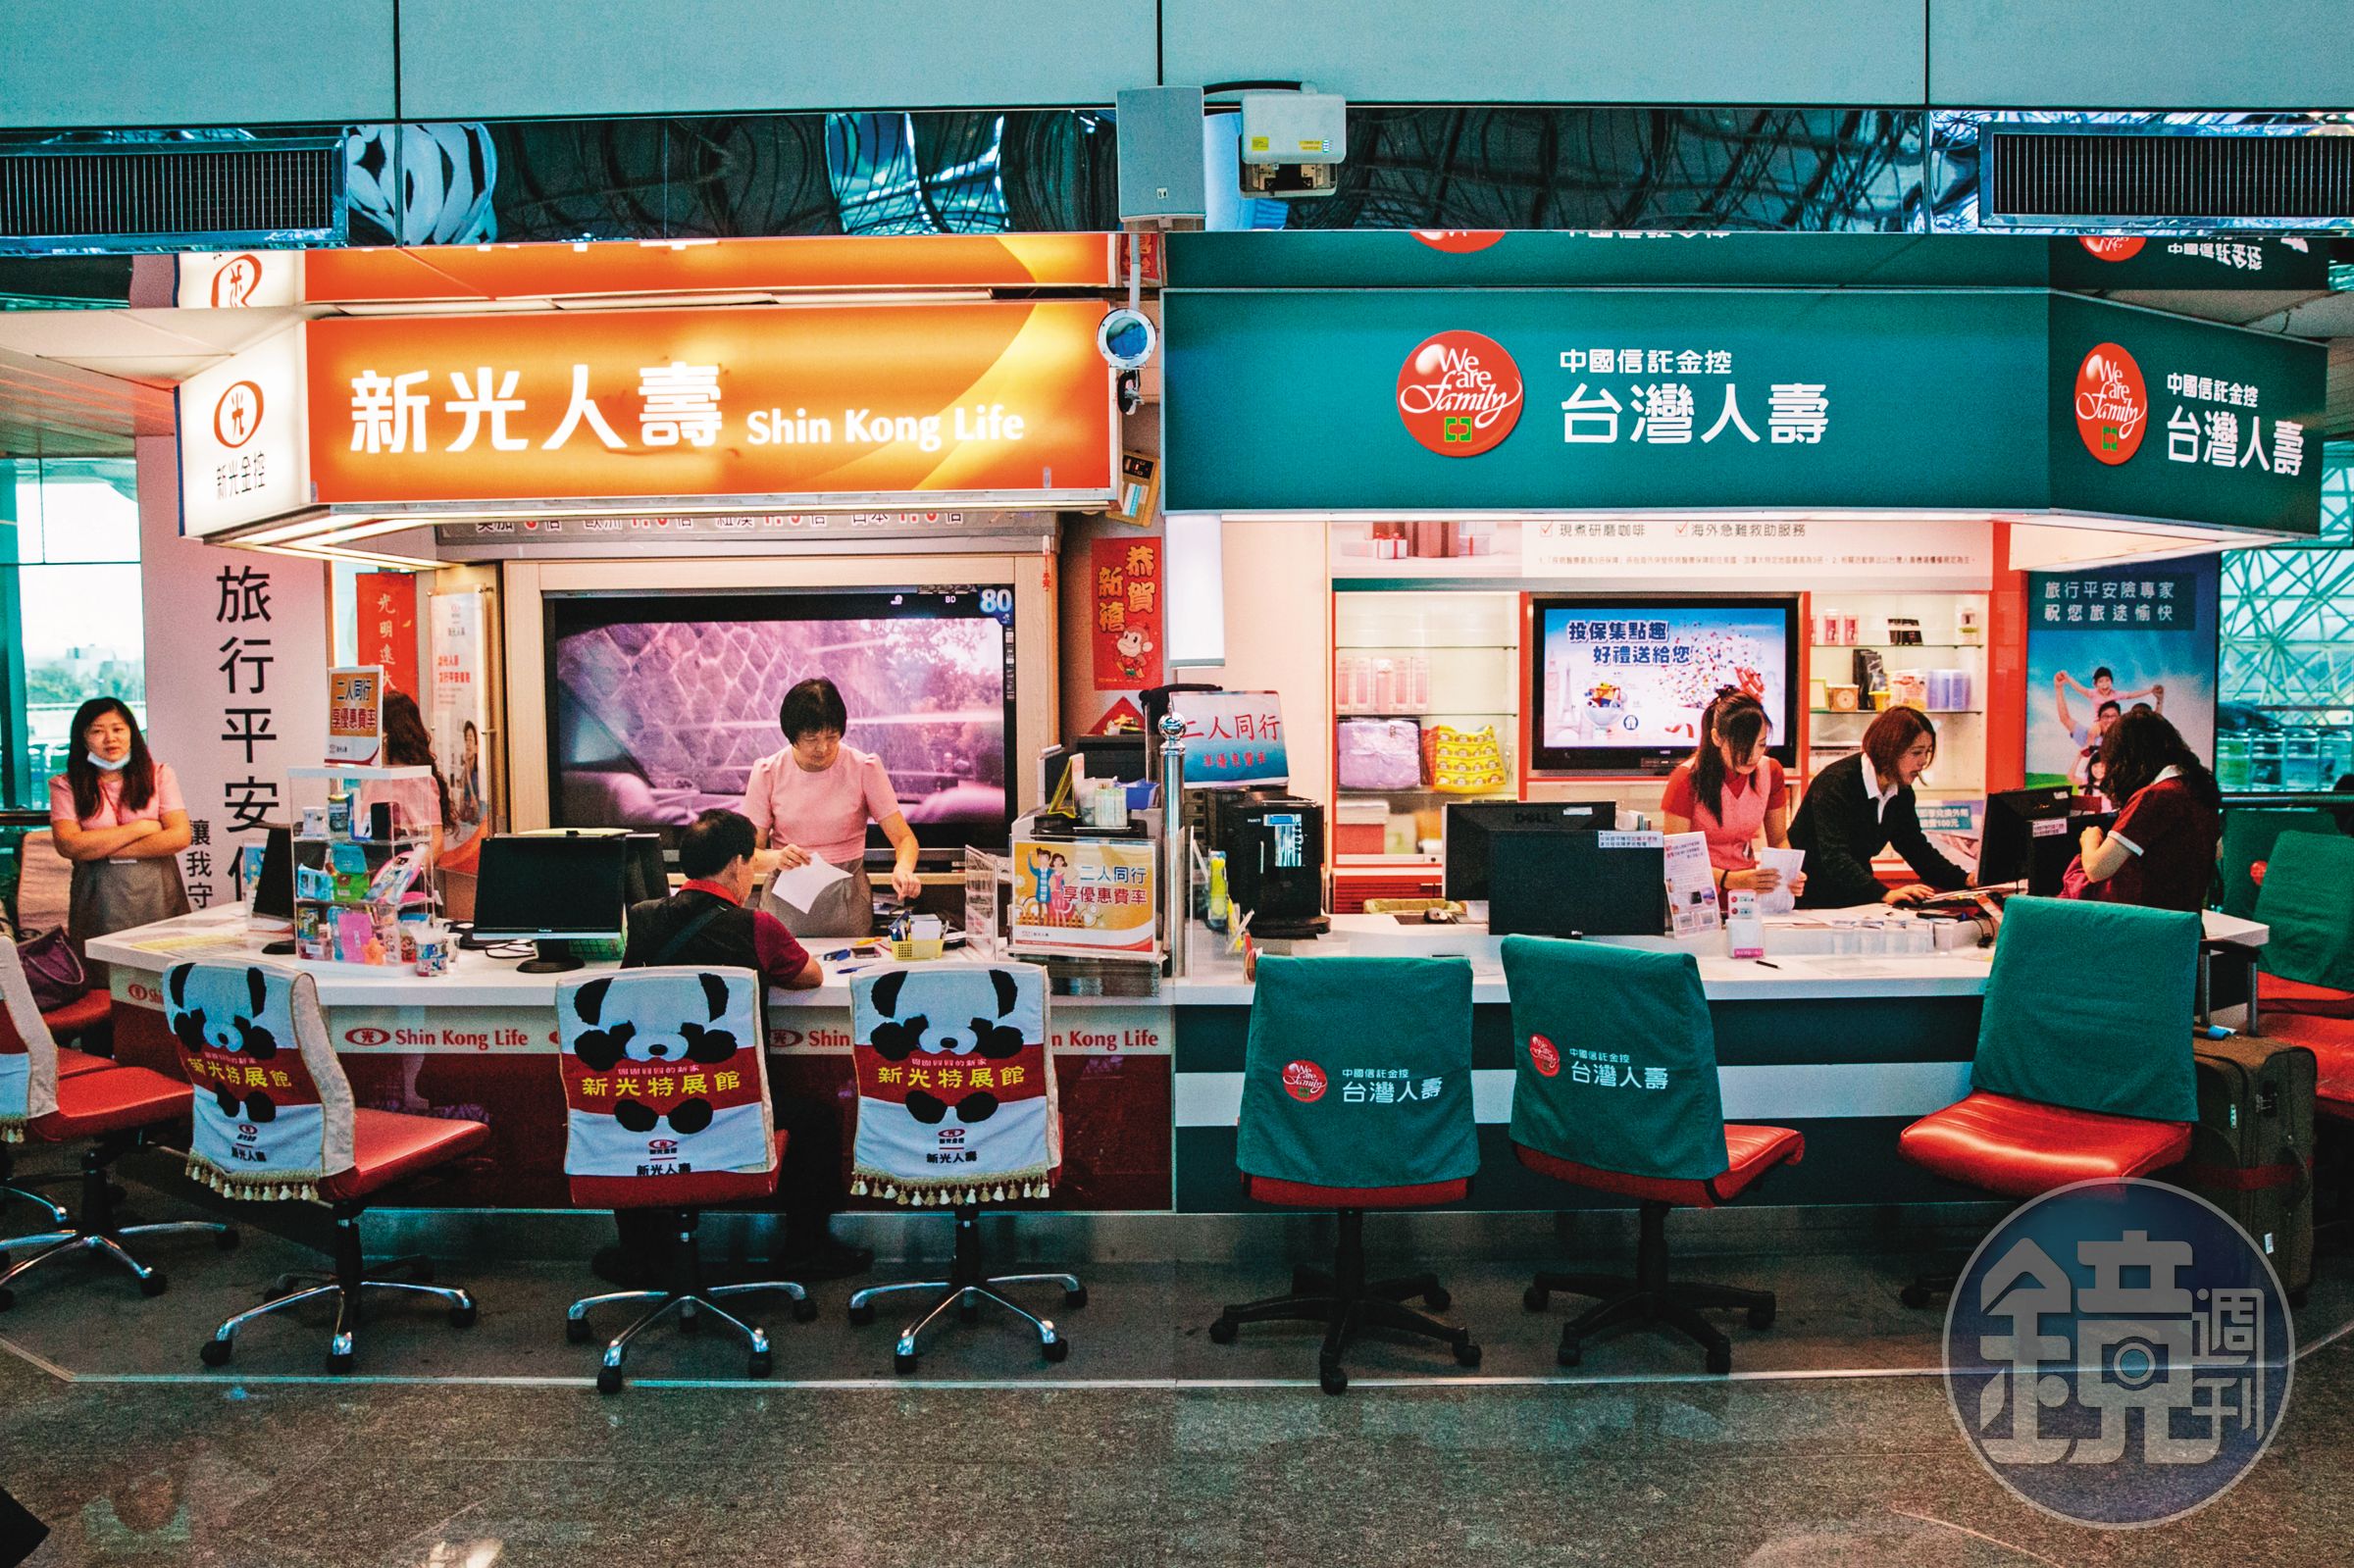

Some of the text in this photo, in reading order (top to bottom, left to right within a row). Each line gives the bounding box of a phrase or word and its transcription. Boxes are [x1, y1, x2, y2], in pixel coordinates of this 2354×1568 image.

[1560, 349, 1732, 374] 中國信託金控
[2167, 373, 2259, 407] 中國信託金控
[350, 362, 723, 453] 新光人壽
[1561, 382, 1829, 443] 台灣人壽
[746, 404, 1024, 452] Shin Kong Life
[2167, 405, 2304, 476] 台灣人壽
[217, 451, 266, 499] 新光金控
[1691, 524, 1806, 537] 海外急難救助服務
[1126, 545, 1154, 614] 恭賀
[2044, 581, 2175, 599] 旅行平安險專家
[980, 588, 1012, 613] 80
[1099, 566, 1125, 632] 新禧
[2044, 604, 2174, 622] 祝您旅途愉快
[1568, 622, 1667, 640] 投保集點趣
[1593, 645, 1691, 664] 好禮送給您
[336, 680, 372, 701] 二人同行
[216, 566, 280, 902] 旅行平安
[1182, 713, 1281, 742] 二人同行
[1080, 866, 1148, 885] 二人同行
[1063, 885, 1148, 907] 享優惠費率
[395, 1028, 529, 1050] Shin Kong Life
[808, 1030, 850, 1047] Shin
[1069, 1031, 1117, 1051] Kong
[1124, 1030, 1158, 1046] Life
[1569, 1048, 1630, 1063] 中國信託金控
[582, 1071, 741, 1097] 新光特展館
[878, 1066, 1025, 1088] 新光特展館
[1343, 1069, 1409, 1079] 中國信託金控
[1571, 1060, 1667, 1089] 台灣人壽
[1343, 1077, 1443, 1103] 台灣人壽
[926, 1151, 977, 1163] 新光人壽
